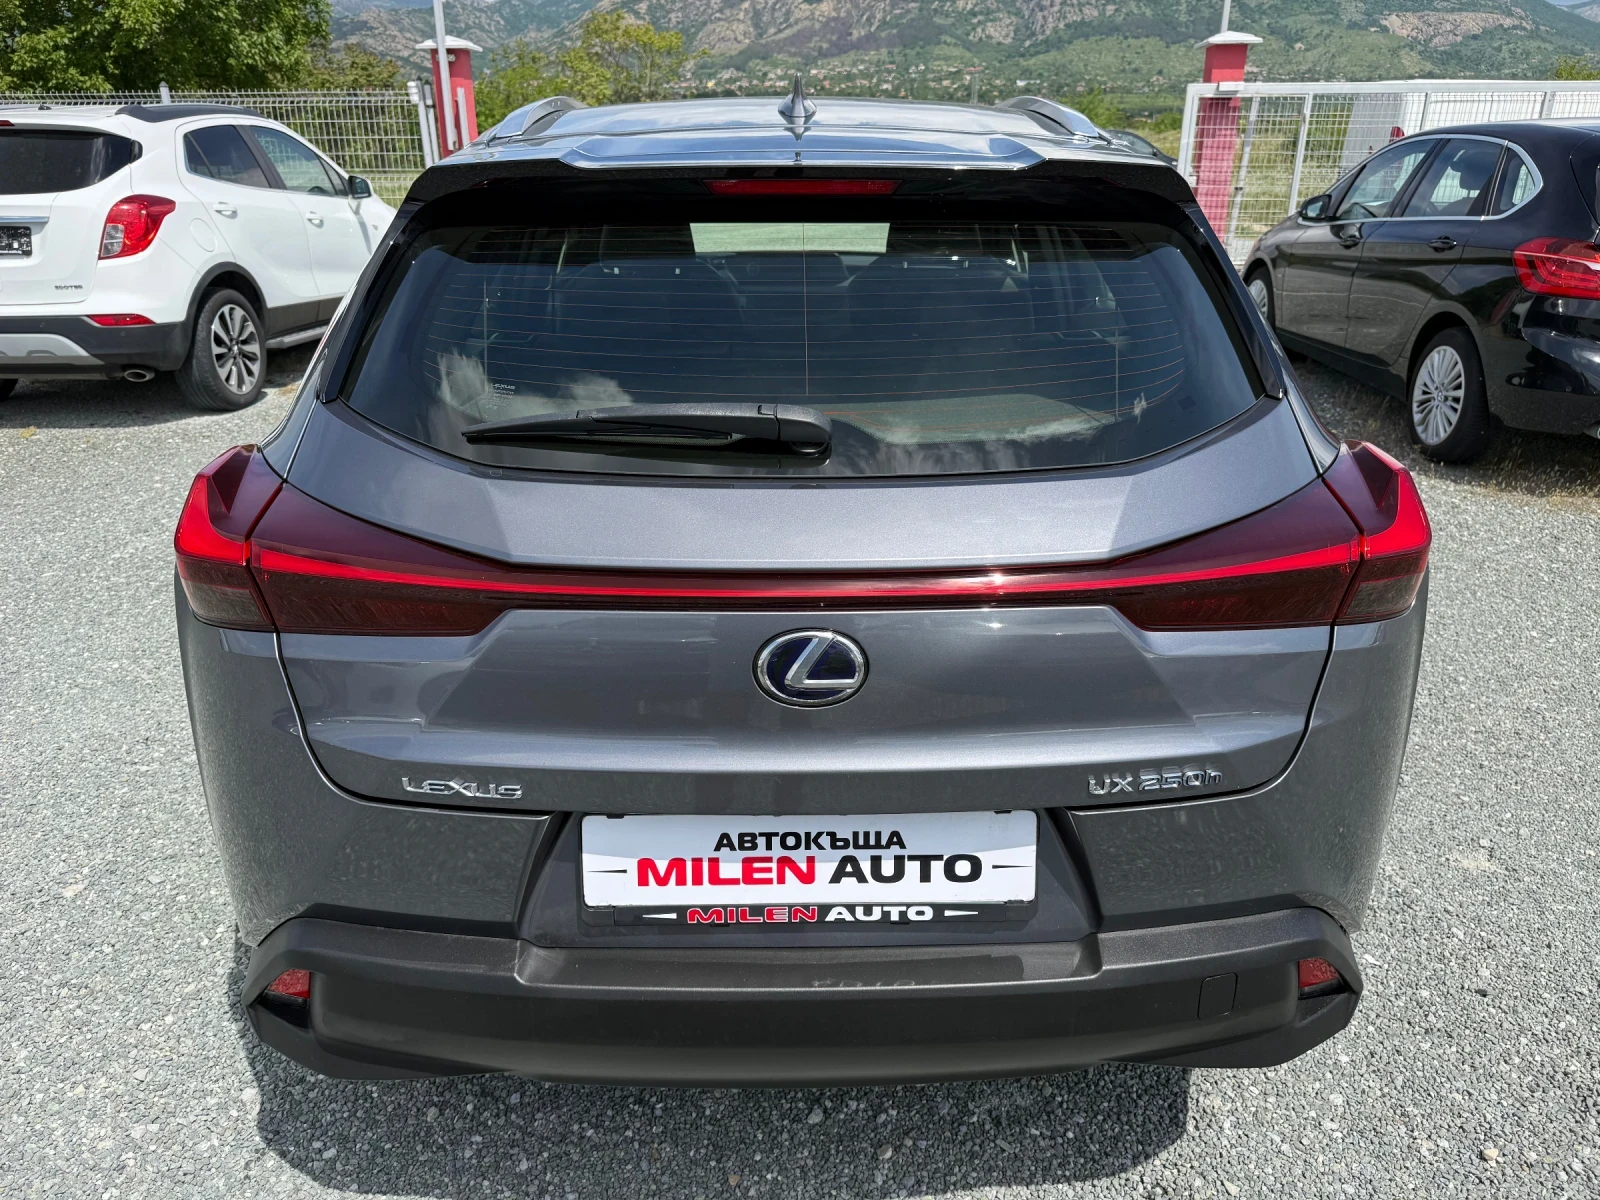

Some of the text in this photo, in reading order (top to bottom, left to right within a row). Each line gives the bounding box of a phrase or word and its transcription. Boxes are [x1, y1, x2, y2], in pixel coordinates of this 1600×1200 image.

[401, 777, 523, 799] LEXUS
[1088, 768, 1223, 795] UX 250h
[636, 854, 983, 887] MILEN AUTO
[686, 906, 935, 924] MILEN AUTO
